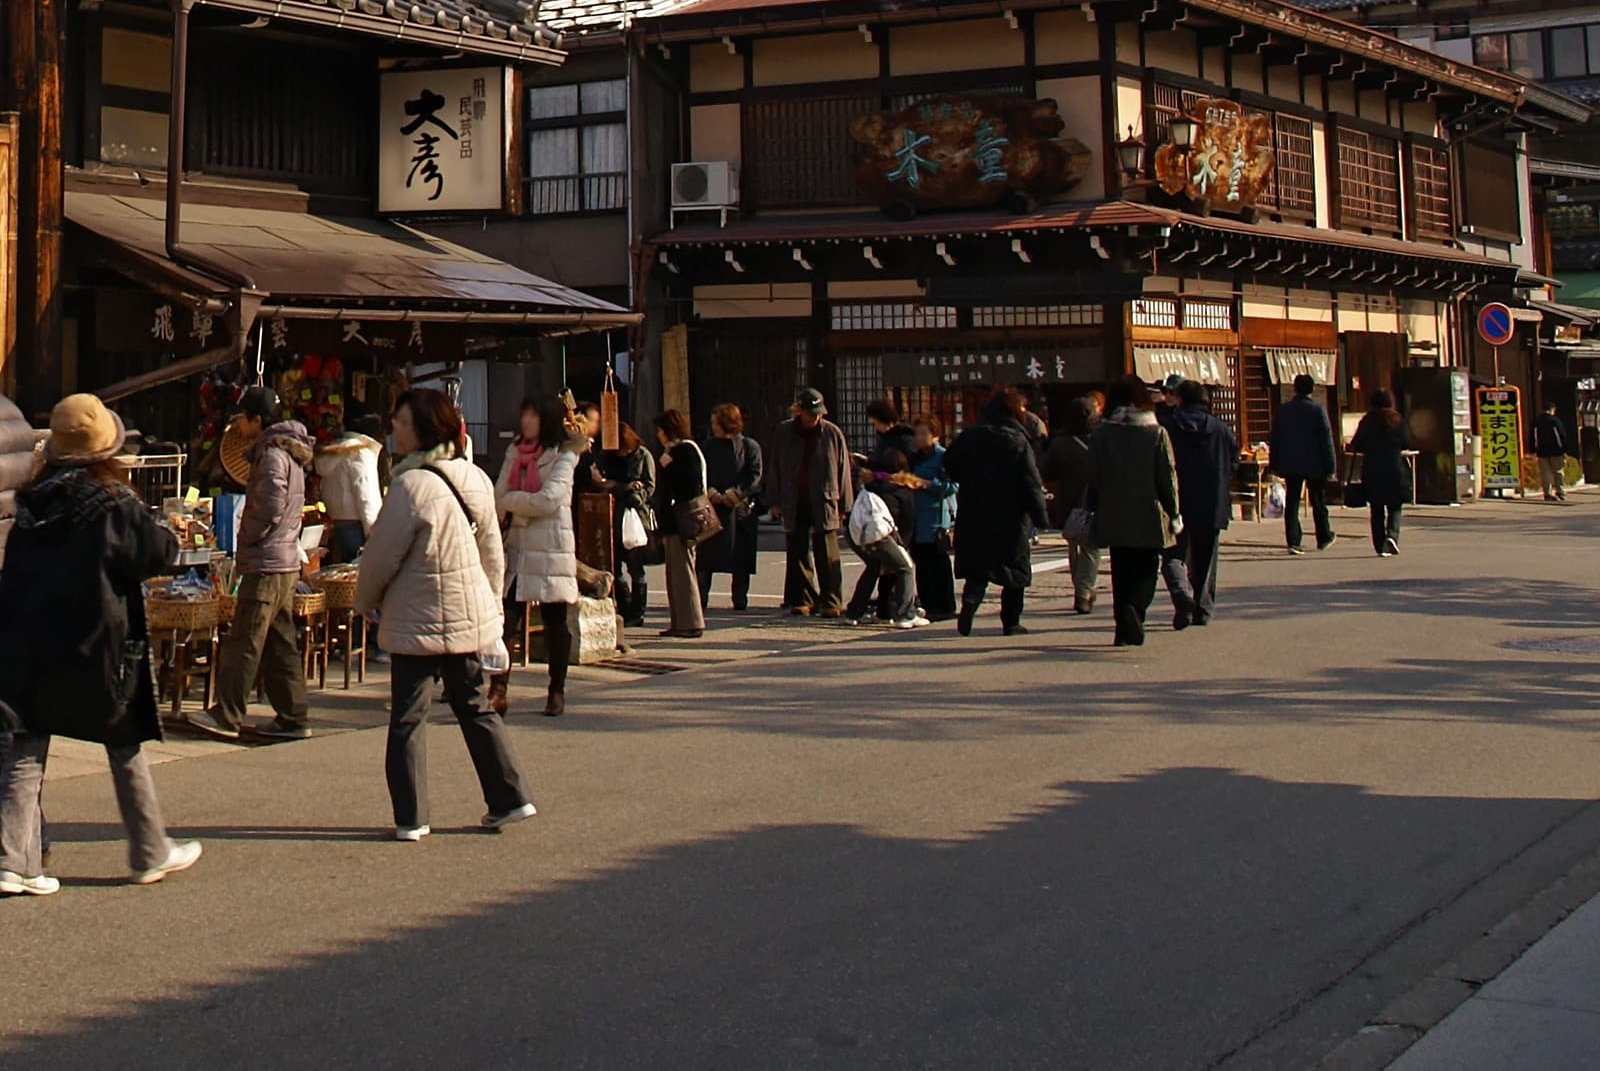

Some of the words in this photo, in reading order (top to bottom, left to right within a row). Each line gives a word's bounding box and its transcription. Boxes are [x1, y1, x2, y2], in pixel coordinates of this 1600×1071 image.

[400, 89, 459, 201] 大彦
[459, 96, 472, 159] 民芸品
[1490, 416, 1511, 475] まわり道
